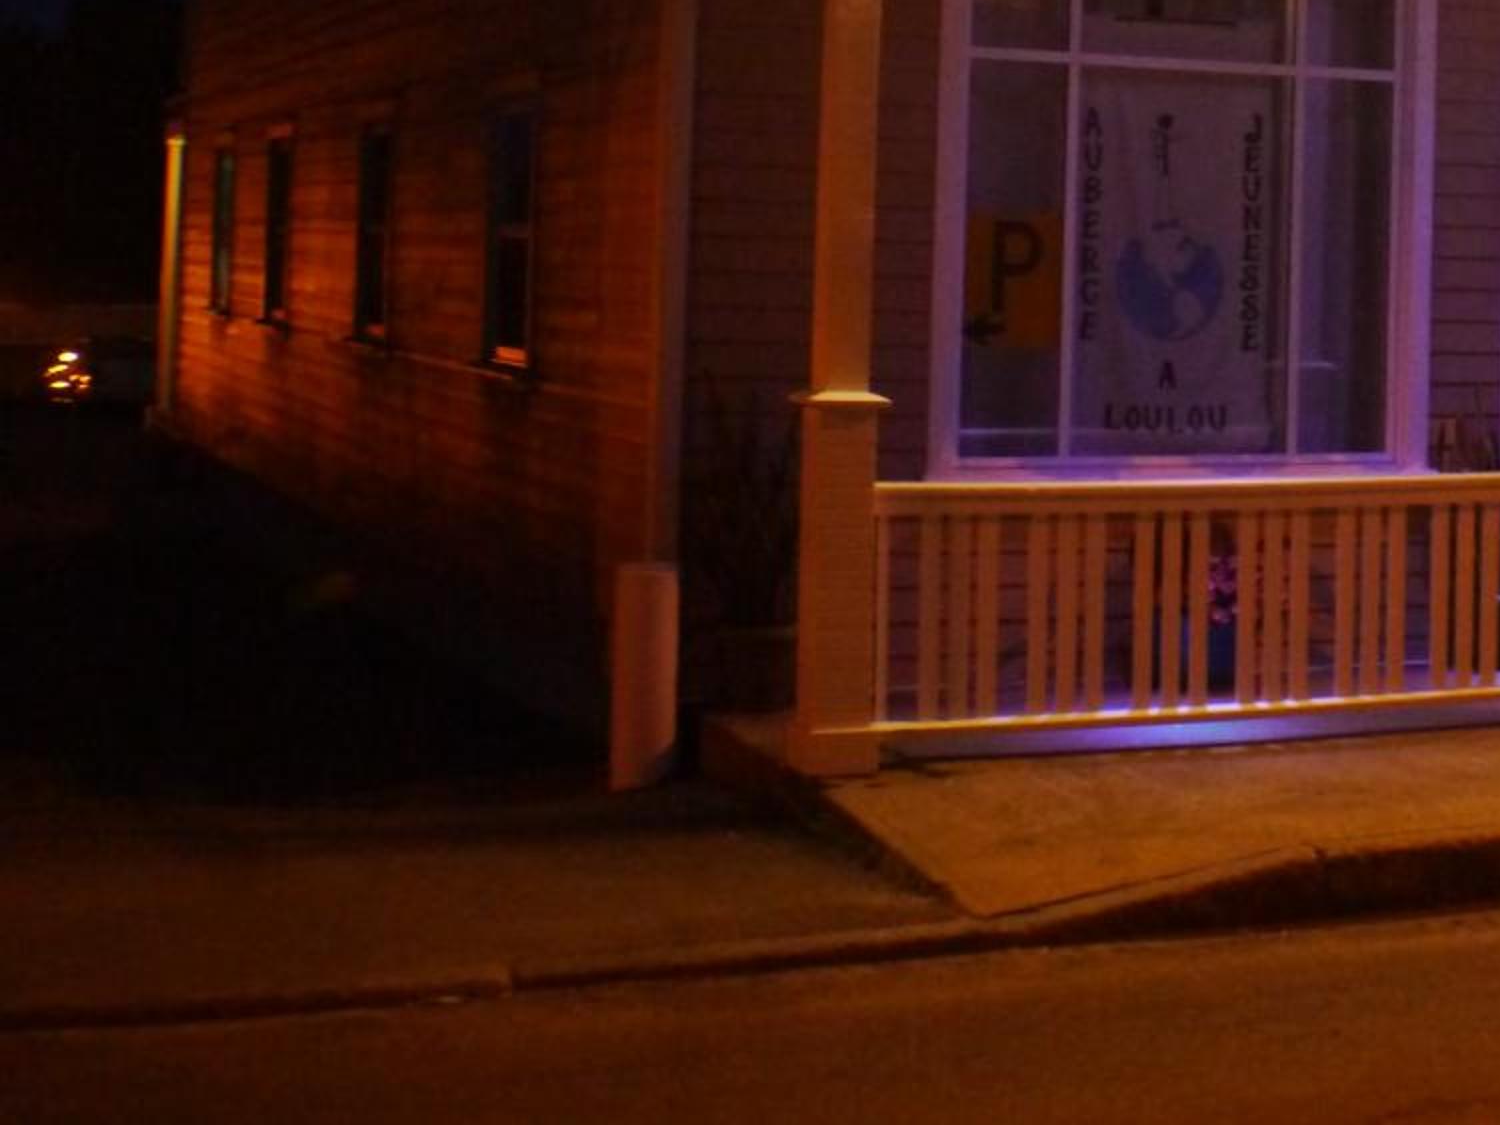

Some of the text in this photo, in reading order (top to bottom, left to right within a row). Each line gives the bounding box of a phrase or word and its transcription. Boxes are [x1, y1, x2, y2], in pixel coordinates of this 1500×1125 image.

[993, 220, 1044, 312] P
[1240, 115, 1264, 352] JEUNESSE
[1104, 404, 1228, 432] LOULOU
